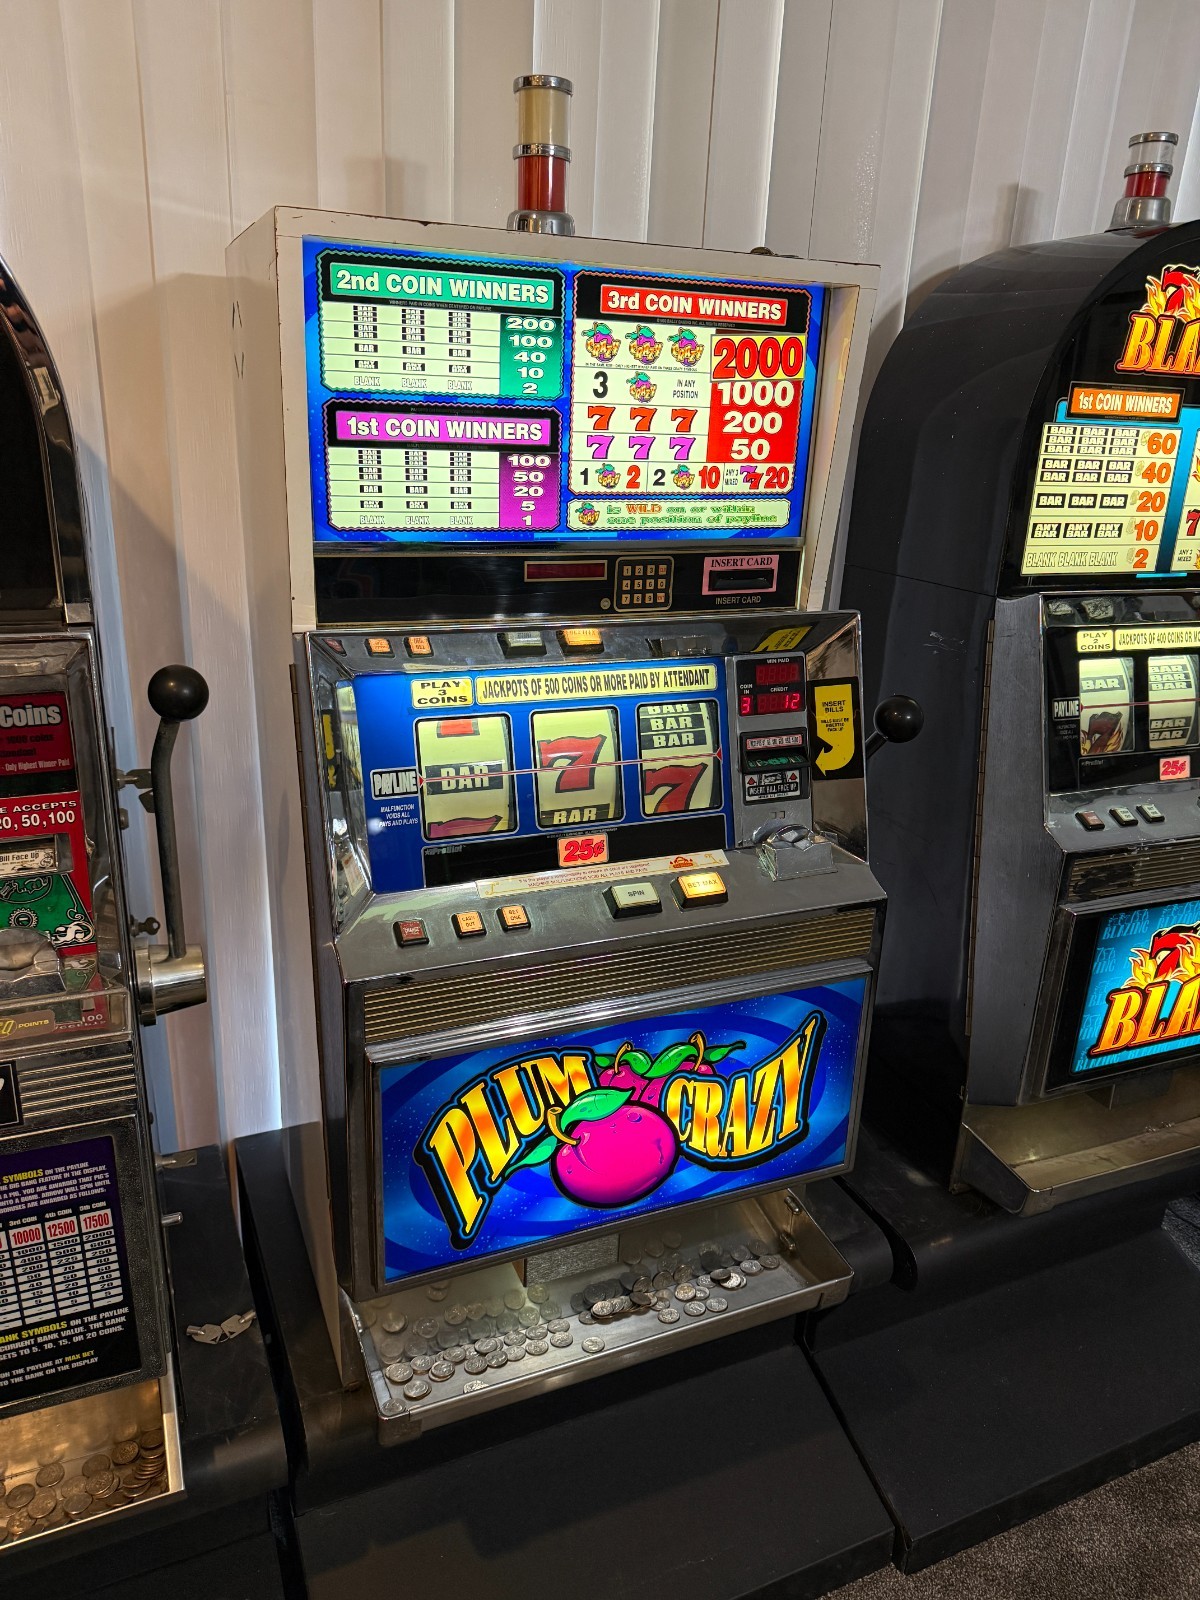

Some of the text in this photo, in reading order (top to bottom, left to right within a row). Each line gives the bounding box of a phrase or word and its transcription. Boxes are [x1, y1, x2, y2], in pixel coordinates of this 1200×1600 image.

[336, 269, 549, 304] 2nd COIN WINNERS
[608, 290, 782, 320] 3rd COIN WINNERS
[505, 316, 556, 331] 200
[509, 334, 553, 348] 100
[514, 351, 546, 363] 40
[712, 337, 804, 379] 2000
[517, 366, 544, 379] 10
[354, 376, 380, 386] BLANK
[448, 380, 473, 390] BLANK
[522, 382, 538, 394] 2
[592, 371, 609, 399] 3
[677, 379, 684, 388] IN
[673, 389, 699, 399] POSITION
[717, 381, 795, 407] 1000
[1079, 392, 1173, 414] 1st COIN WINNERS
[588, 406, 783, 435] 7 7 7 200
[347, 416, 543, 441] 1st COIN WINNERS
[587, 434, 771, 461] 7 7 7 50
[1147, 432, 1177, 455] 60
[507, 454, 551, 467] 100
[513, 470, 544, 483] 50
[580, 465, 721, 489] 1 2 2 10
[764, 466, 790, 489] 20
[1142, 462, 1171, 484] 40
[513, 486, 544, 498] 20
[521, 501, 536, 511] 5
[626, 504, 662, 514] WILD
[1039, 491, 1166, 512] BAR BAR 20
[360, 515, 385, 525] BLANK
[450, 516, 473, 525] BLANK
[522, 516, 532, 526] 1
[1134, 520, 1159, 541] 10
[711, 557, 773, 568] INSERT CARD
[1026, 548, 1149, 568] BLANK BLANK 2
[715, 596, 762, 605] INSERT CARD
[1119, 633, 1147, 645] JACKPOTS
[1149, 633, 1156, 643] OF
[1157, 633, 1166, 643] 400
[1168, 632, 1183, 643] COINS
[1186, 631, 1194, 642] OR
[420, 681, 461, 690] PLAY
[482, 668, 710, 699] JACKPOTS OF 500 COINS OR MORE PAID BY ATTENDANT
[1081, 678, 1120, 691] BAR
[1151, 682, 1187, 690] BAR
[417, 696, 469, 705] COINS
[742, 697, 751, 714] 3
[785, 693, 800, 709] 12
[1, 704, 61, 728] Coins
[1054, 700, 1079, 717] PAYLINE
[651, 717, 693, 731] BAR
[1151, 719, 1186, 729] BAR
[653, 733, 695, 748] BAR
[1150, 730, 1183, 739] BAR
[18, 760, 38, 771] Highest
[38, 759, 57, 768] Winner
[58, 758, 70, 766] Paid
[537, 734, 607, 794] 7
[1161, 760, 1187, 776] 25¢
[373, 771, 418, 796] PAYLINE
[440, 765, 490, 791] BAR
[749, 786, 766, 795] INSERT
[767, 785, 778, 793] BILL
[778, 784, 790, 792] FACE
[13, 800, 77, 813] ACCEPTS
[381, 804, 415, 813] MALFUNCTION
[386, 811, 401, 819] VOIDS
[552, 807, 597, 825] BAR
[378, 818, 418, 828] PAYS AND PLAYS
[30, 852, 40, 860] Up
[563, 838, 605, 862] 25¢
[627, 889, 645, 897] SPIN
[18, 1020, 50, 1029] POINTS
[665, 1017, 816, 1157] CRAZY
[429, 1055, 591, 1234] PLUM
[2, 1161, 89, 1183] SYMBOLS PAYLINE
[82, 1212, 110, 1230] 17500
[47, 1220, 76, 1238] 12500
[84, 1231, 113, 1240] 2000
[12, 1228, 41, 1246] 10000
[22, 1307, 129, 1339] SYMBOLS ON THE PAYLINE
[0, 1316, 126, 1352] CURRENT BANK VALUE. THE BANK
[25, 1357, 99, 1380] BANK DISPLAY
[26, 1354, 81, 1372] PAYLINE MAX
